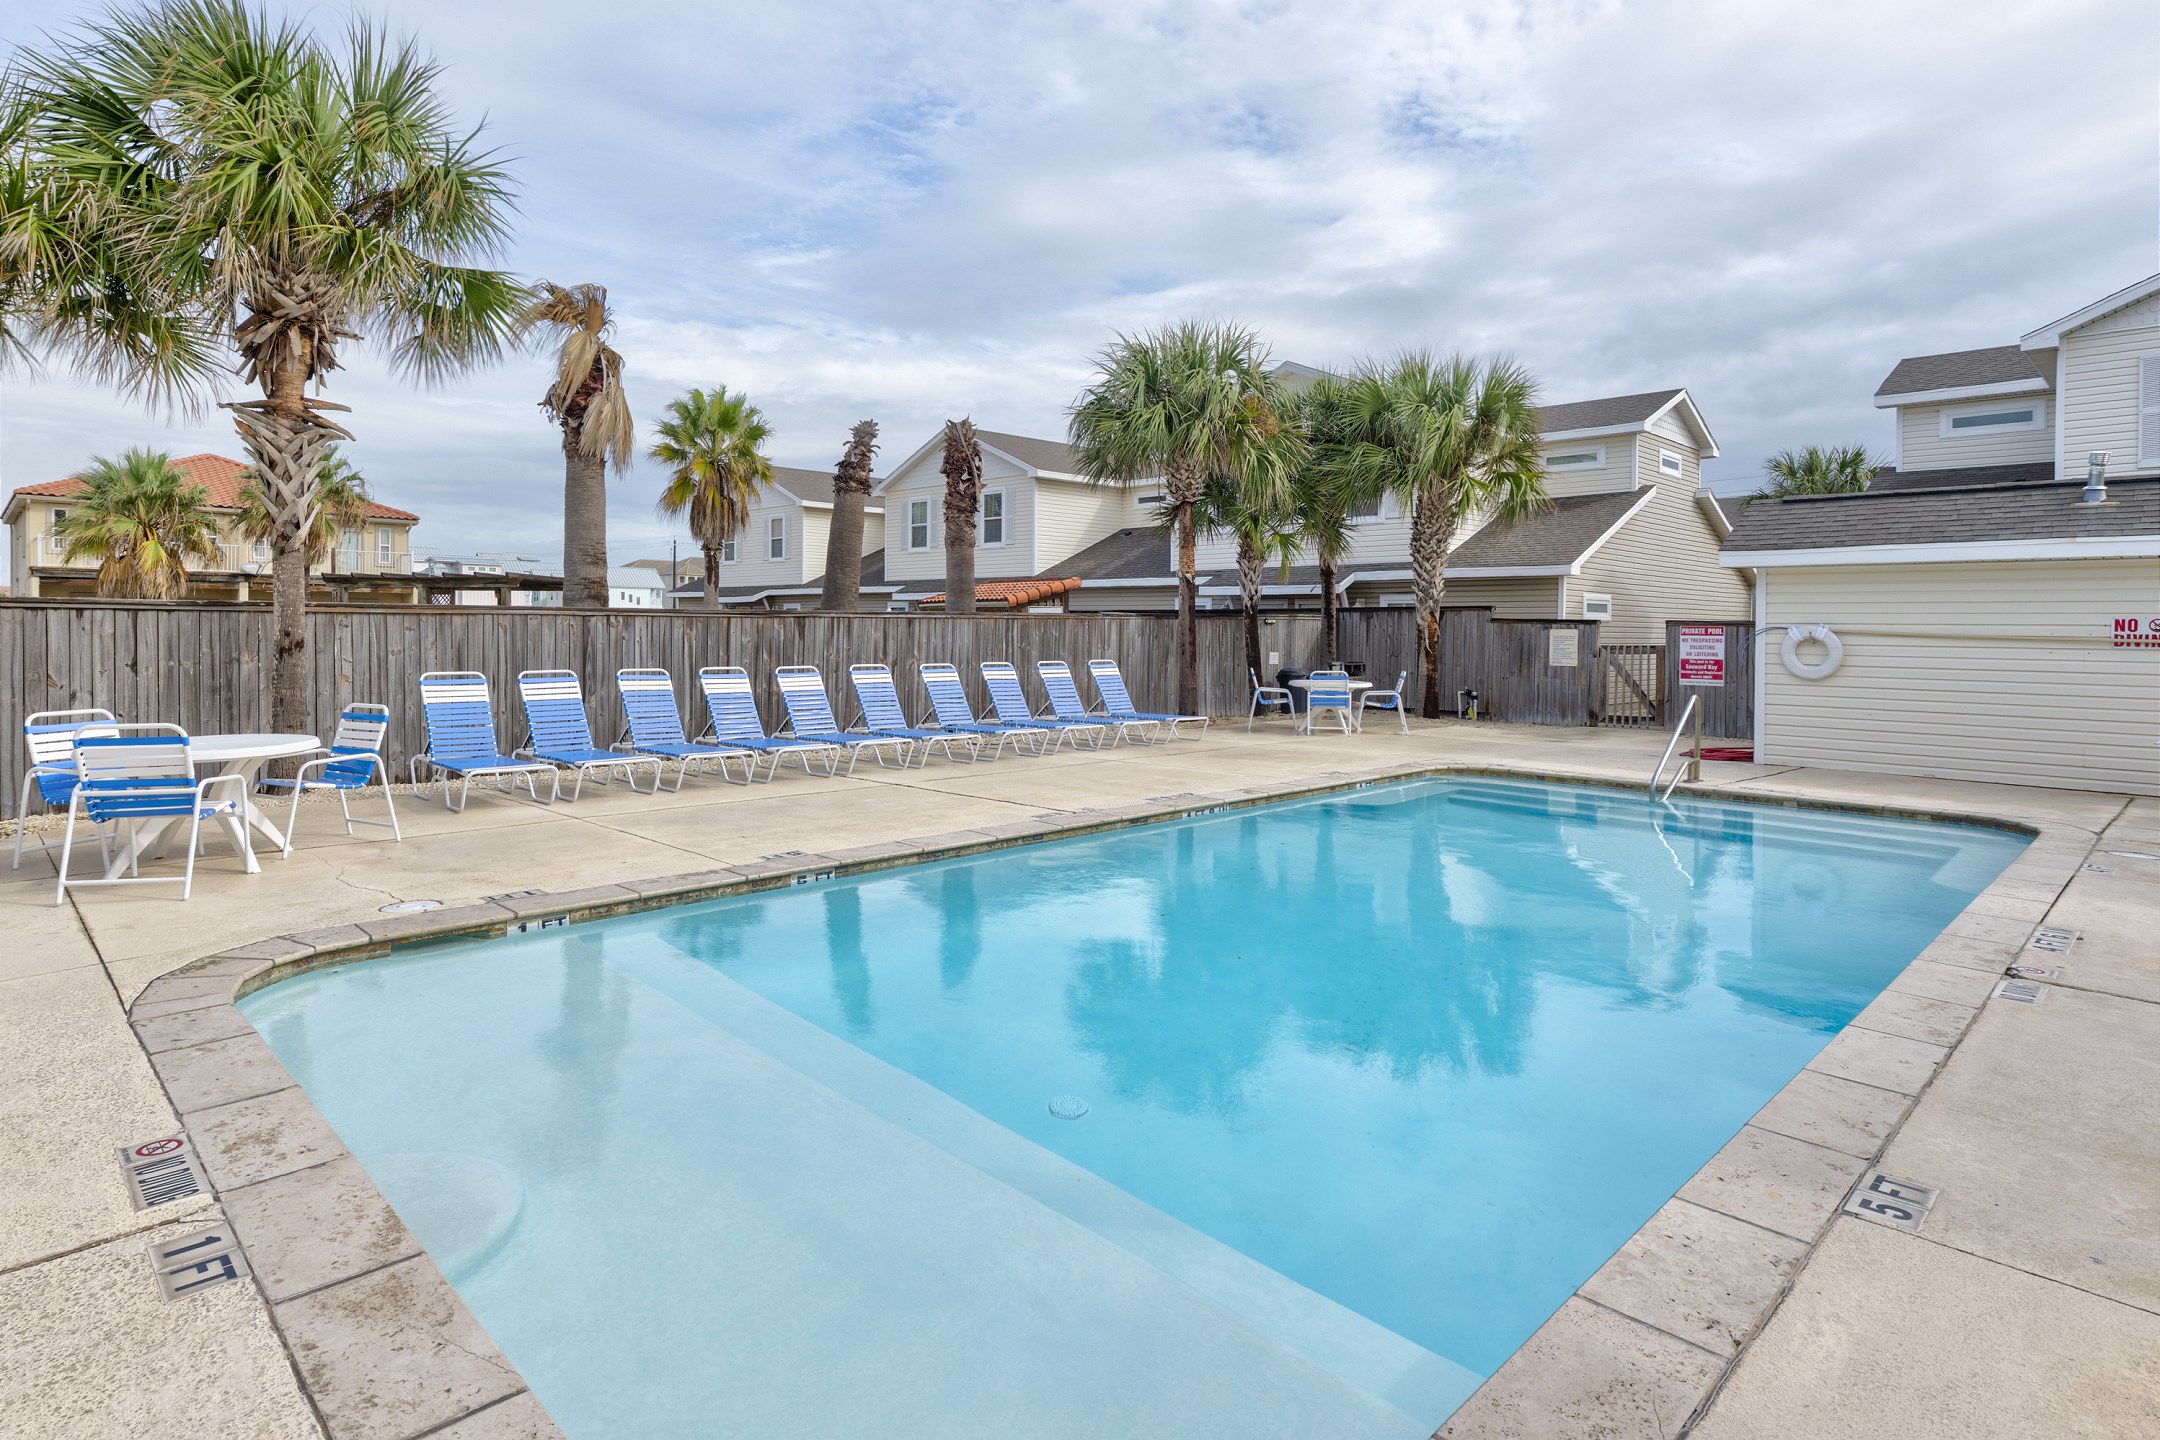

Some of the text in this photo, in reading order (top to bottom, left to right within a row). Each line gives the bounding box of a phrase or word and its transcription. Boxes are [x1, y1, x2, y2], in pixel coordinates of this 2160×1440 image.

[1681, 627, 1706, 635] PRIVATE
[2114, 618, 2138, 632] NO
[517, 915, 567, 933] 1 FT
[133, 1154, 200, 1208] NO DIVING
[1857, 1174, 1927, 1221] 5 FT
[163, 1235, 238, 1293] 1 FT
